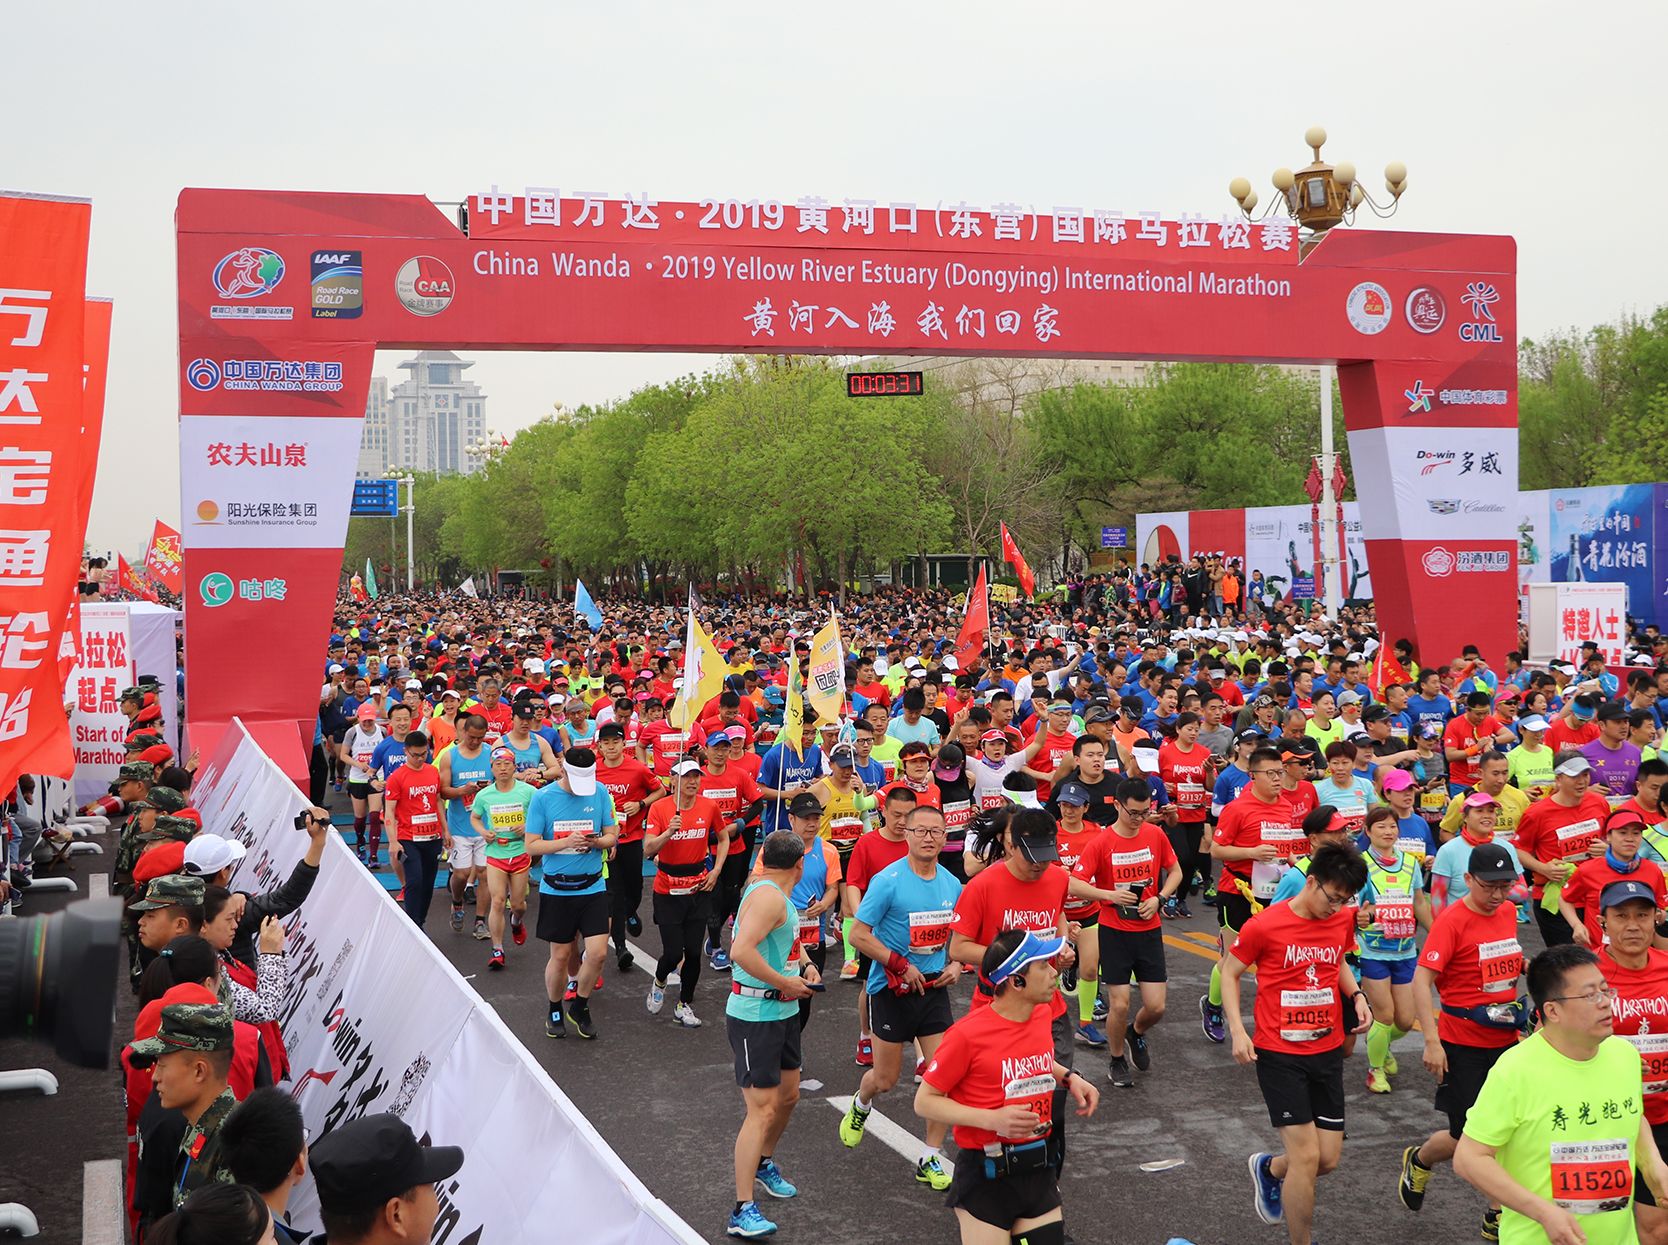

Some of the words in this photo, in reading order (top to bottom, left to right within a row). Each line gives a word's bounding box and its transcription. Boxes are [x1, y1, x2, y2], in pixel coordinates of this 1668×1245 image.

[314, 253, 351, 265] IAAF
[473, 250, 539, 277] China
[552, 252, 631, 278] Wanda
[662, 256, 716, 280] 2019
[722, 256, 795, 283] Yellow
[801, 258, 856, 284] River
[861, 261, 938, 291] Estuary
[944, 262, 1059, 294] (Dongying)
[1065, 266, 1192, 293] International
[1199, 271, 1291, 297] Marathon
[316, 286, 337, 295] Road
[339, 287, 359, 295] Race
[418, 280, 450, 292] CAA
[315, 294, 343, 304] GOLD
[315, 309, 337, 318] Label
[742, 297, 898, 338] 黄河入海
[916, 300, 1061, 343] 我们回家
[1459, 322, 1503, 342] CML
[223, 360, 343, 381] 中国万达集团
[224, 381, 259, 391] CHINA
[262, 382, 301, 391] WANDA
[304, 382, 343, 391] GROUP
[207, 442, 307, 467] 农夫山泉
[1416, 450, 1456, 459] Do-win
[1457, 451, 1502, 476] 多威
[227, 502, 318, 518] 阳光保险集团
[1457, 551, 1509, 564] 汾酒集团
[239, 577, 288, 601] 咕咚
[1562, 607, 1619, 641] 特邀人士
[78, 676, 119, 714] 起点
[76, 725, 108, 742] Start
[111, 726, 124, 742] of
[983, 799, 1001, 808] 202
[493, 814, 523, 825] 34866
[1116, 864, 1151, 880] 10164
[1002, 908, 1056, 930] MARATHON
[913, 926, 949, 942] 14985
[1283, 944, 1342, 968] MARATHON
[1487, 958, 1522, 978] 11683
[1286, 1009, 1330, 1025] 10051
[1002, 1048, 1055, 1088] MARATHON
[1560, 1168, 1628, 1192] 11520
